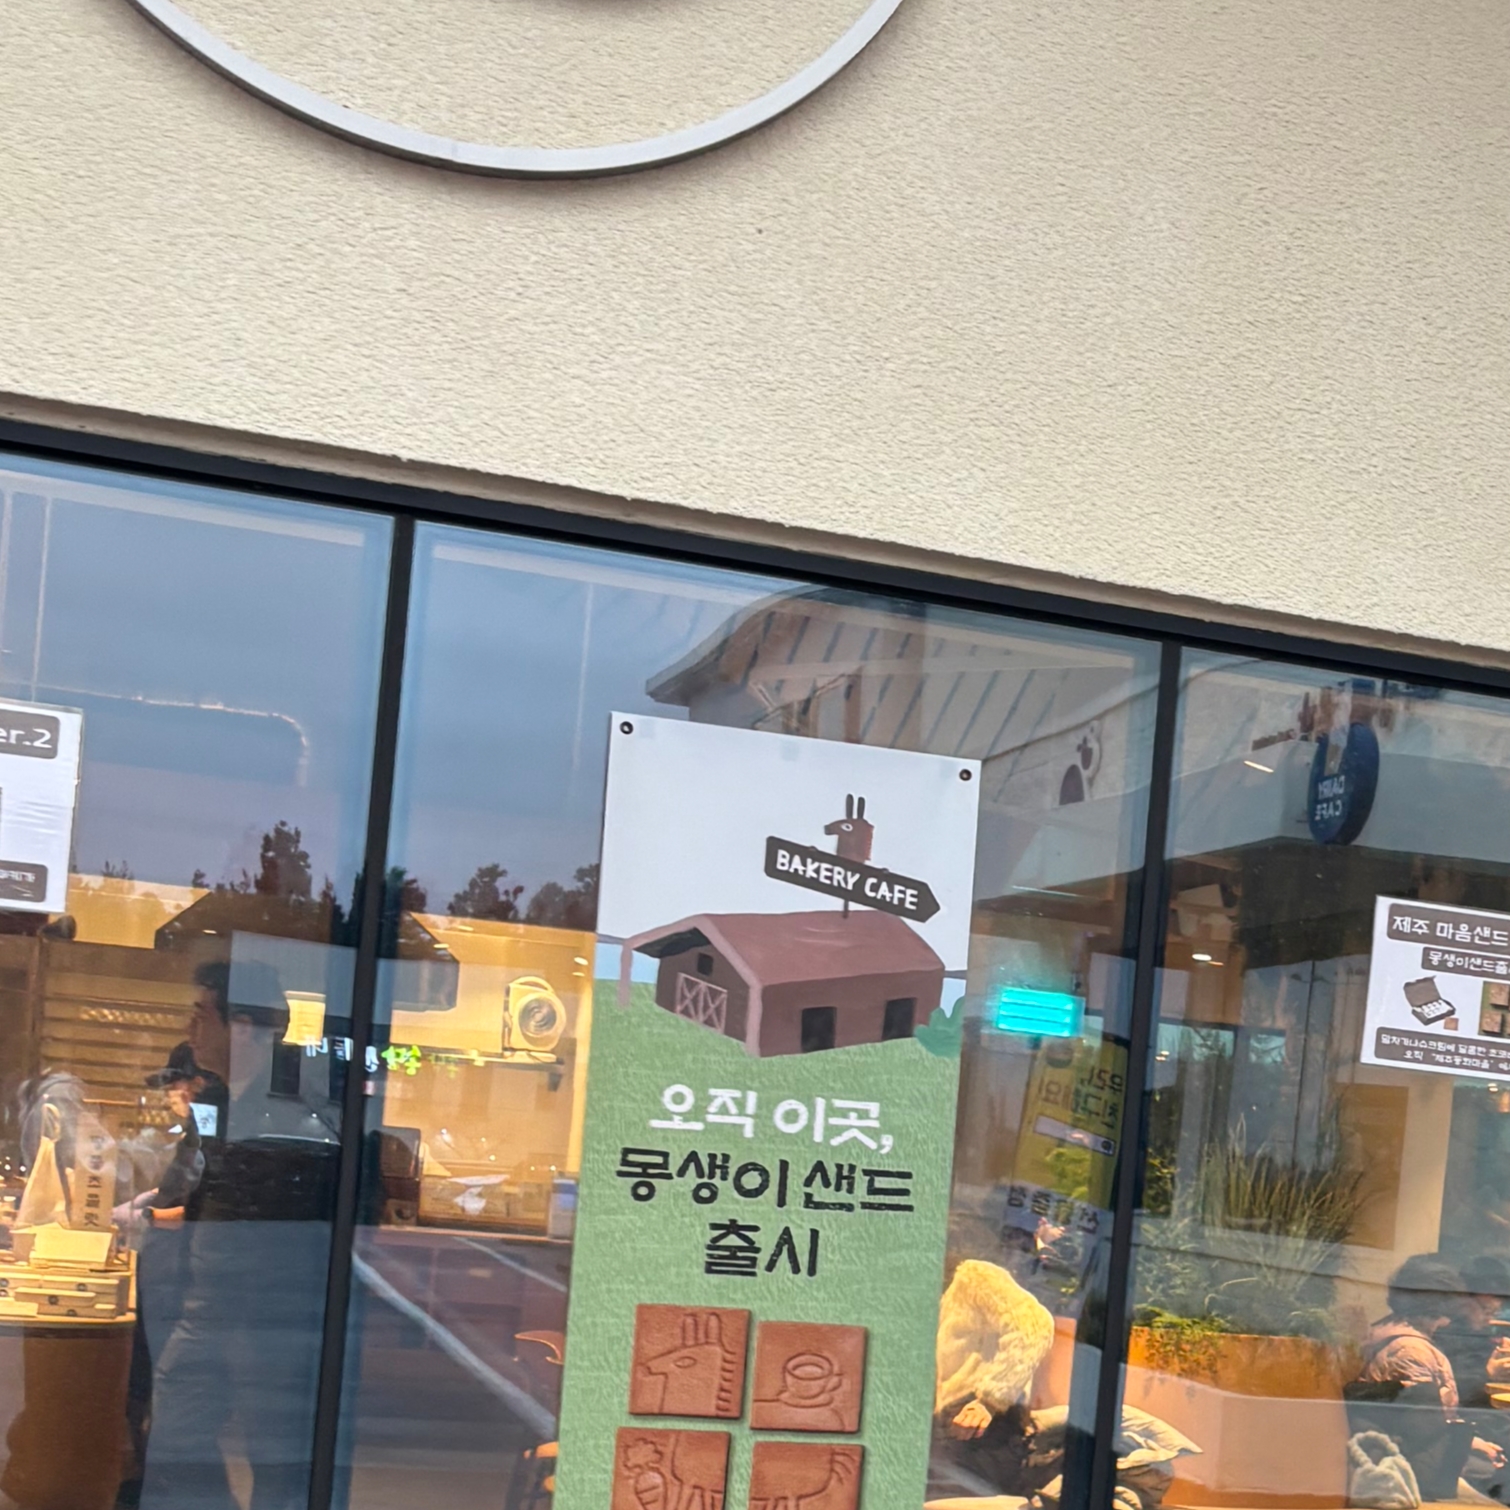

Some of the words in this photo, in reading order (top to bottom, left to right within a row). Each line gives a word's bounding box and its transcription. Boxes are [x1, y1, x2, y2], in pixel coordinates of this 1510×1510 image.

[776, 849, 860, 891] BAKERY
[864, 877, 918, 911] CAFE
[1392, 916, 1430, 935] 제주
[1435, 921, 1509, 946] 마음샌드
[1403, 1050, 1424, 1061] 오직
[649, 1084, 758, 1138] 오직
[773, 1097, 893, 1154] 이곳,
[704, 1218, 819, 1277] 출시
